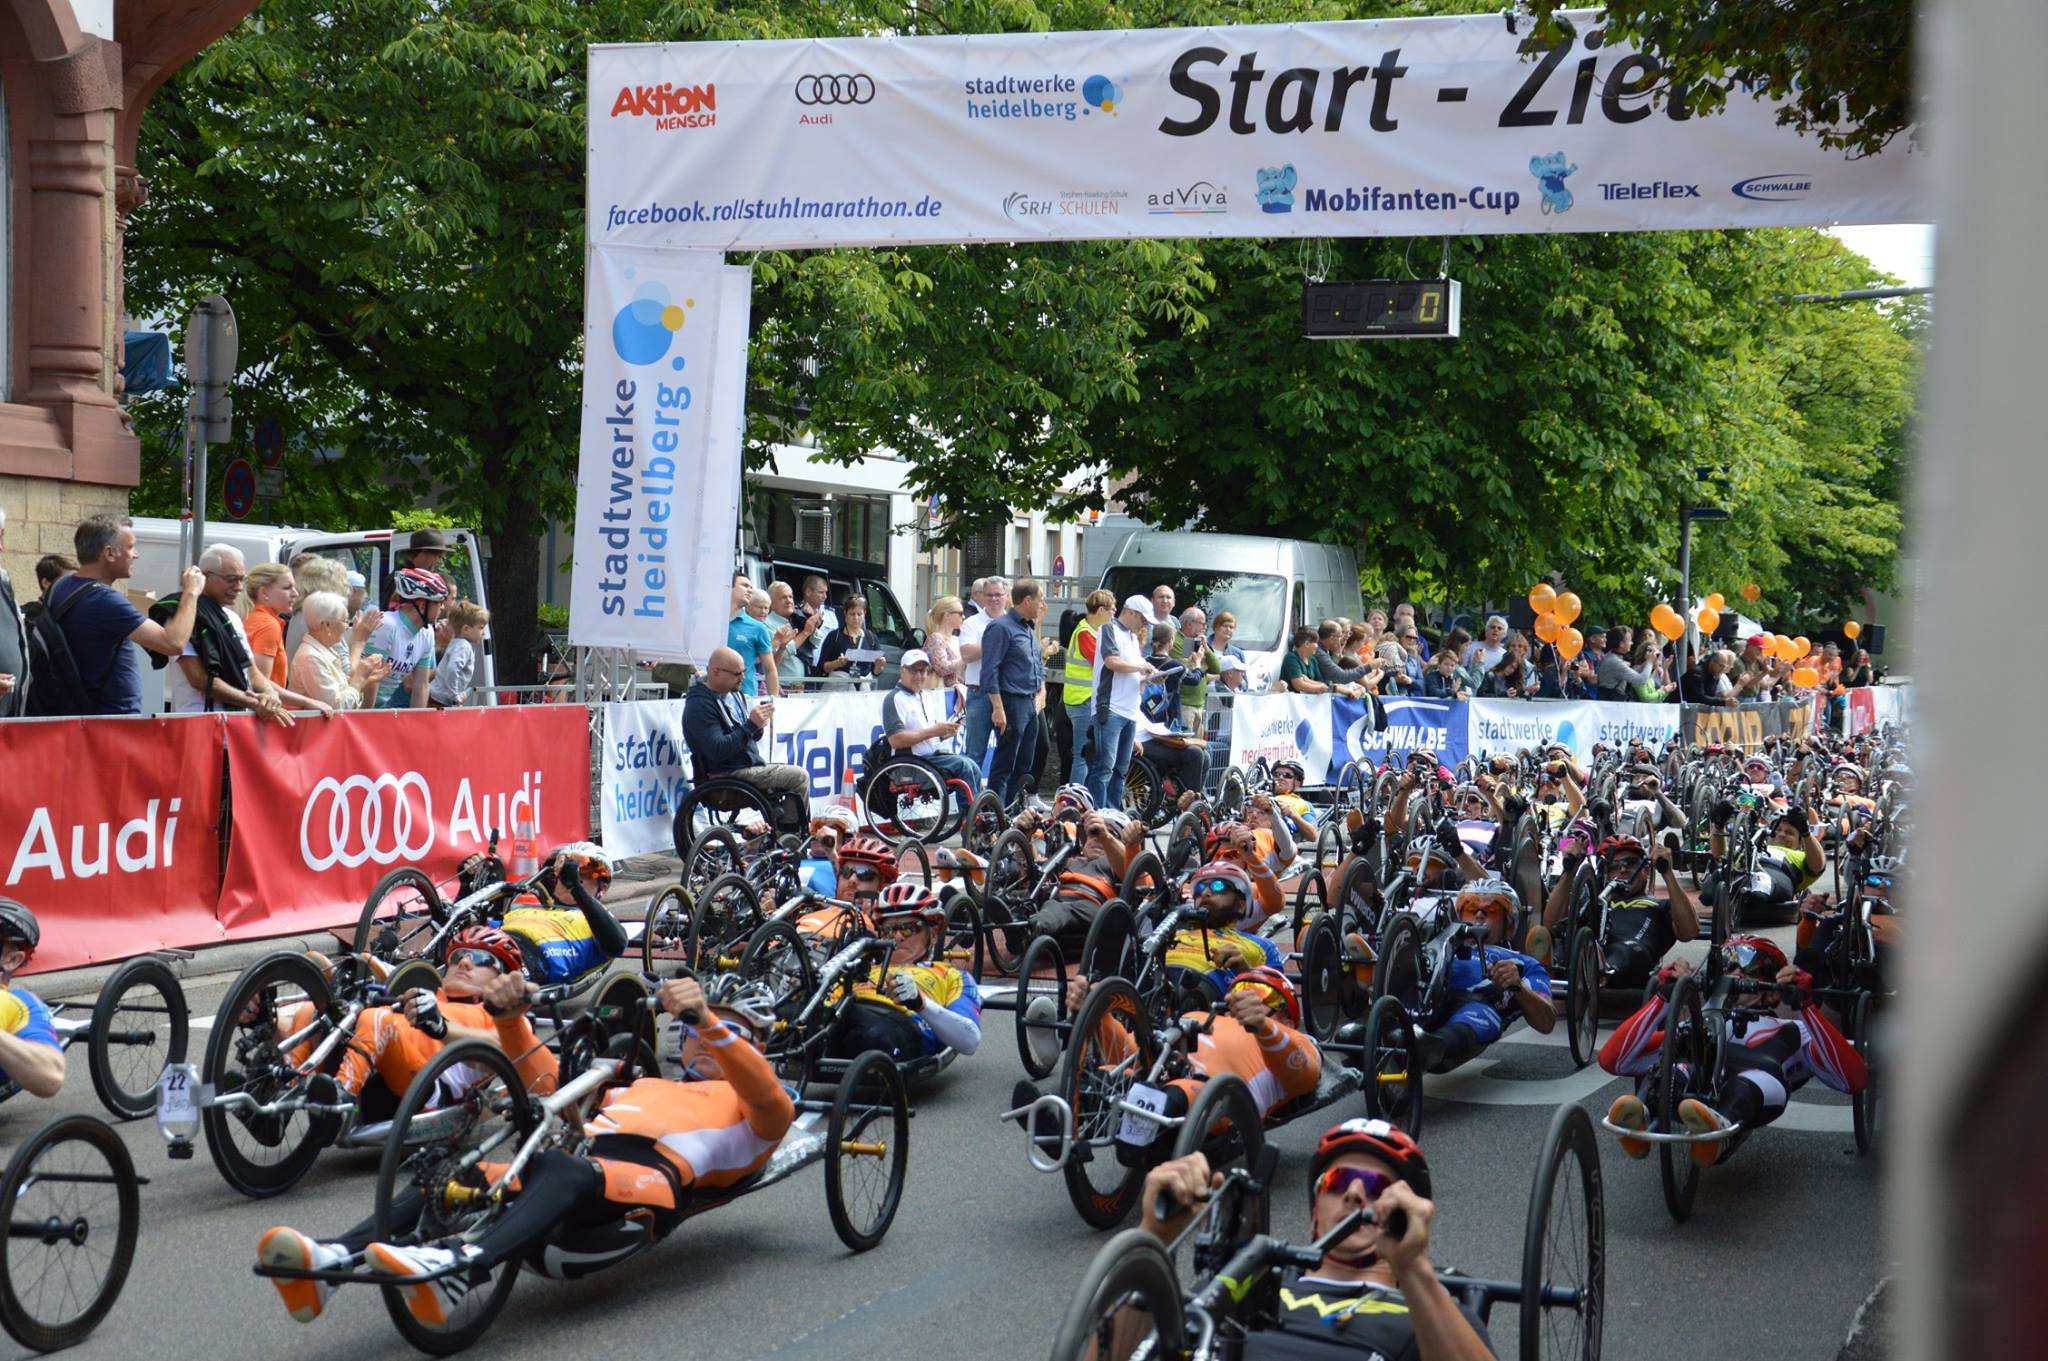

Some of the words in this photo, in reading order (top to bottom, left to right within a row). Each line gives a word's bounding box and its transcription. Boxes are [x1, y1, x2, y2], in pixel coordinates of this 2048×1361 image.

[965, 74, 1076, 95] stadtwerke
[1159, 45, 1409, 136] Start
[1436, 87, 1469, 103] -
[799, 114, 832, 124] Audi
[967, 98, 1078, 121] heidelberg
[656, 113, 716, 131] MENSCH
[1597, 181, 1702, 200] Teleflex
[1746, 182, 1813, 192] SCHWALBE
[1019, 201, 1053, 215] SRH
[1058, 200, 1120, 216] SCHULEN
[1304, 186, 1520, 215] Mobifanten-Cup
[606, 195, 943, 231] facebook.rollstuhlmarathon.de
[598, 378, 637, 617] stadtwerke
[634, 382, 693, 618] heidelberg
[1363, 725, 1448, 750] SCHWALBE
[1478, 717, 1553, 741] stadtwerke
[449, 770, 542, 847] Audi
[6, 797, 182, 886] Audi
[167, 1071, 186, 1091] 22
